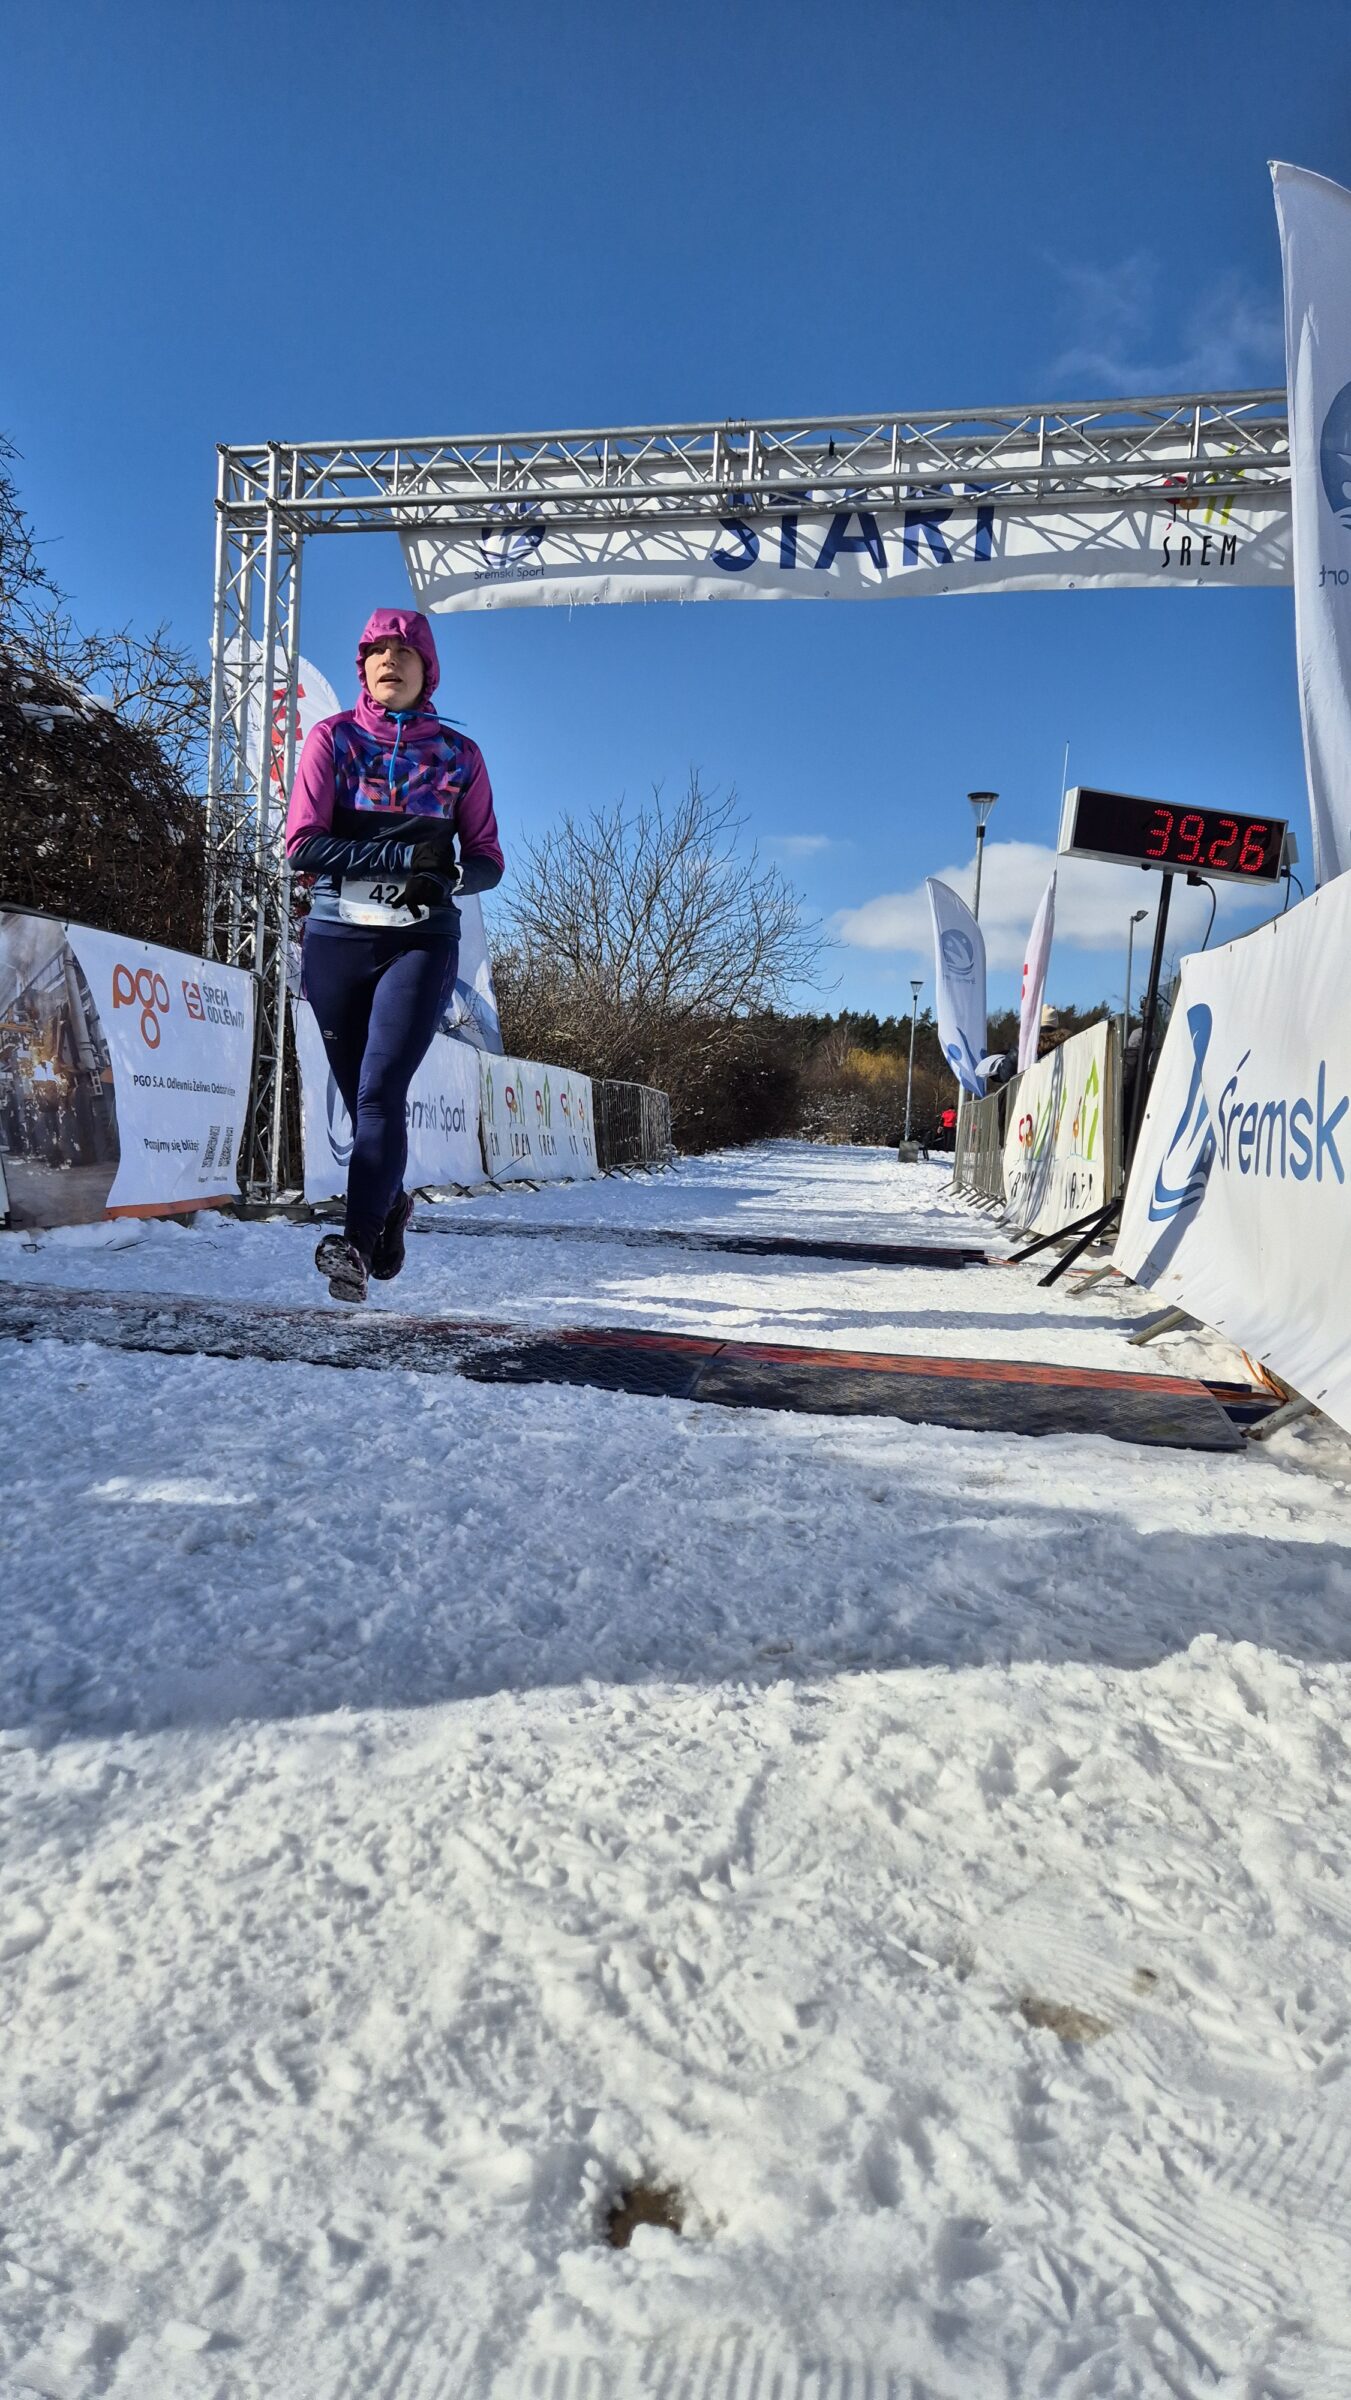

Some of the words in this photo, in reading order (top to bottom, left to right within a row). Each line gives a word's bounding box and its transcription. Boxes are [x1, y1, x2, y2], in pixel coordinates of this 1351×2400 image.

[711, 480, 1010, 571] START
[1161, 523, 1238, 568] ŚREM
[473, 567, 513, 580] Śremski
[516, 566, 545, 580] Sport
[1145, 809, 1268, 872] 39.26
[368, 884, 399, 905] 42
[202, 982, 230, 1007] ŚREM
[133, 1074, 151, 1087] PGO
[152, 1075, 166, 1088] S.A.
[166, 1077, 193, 1091] Odlewnia
[405, 1092, 436, 1129] emski
[171, 1139, 182, 1154] się
